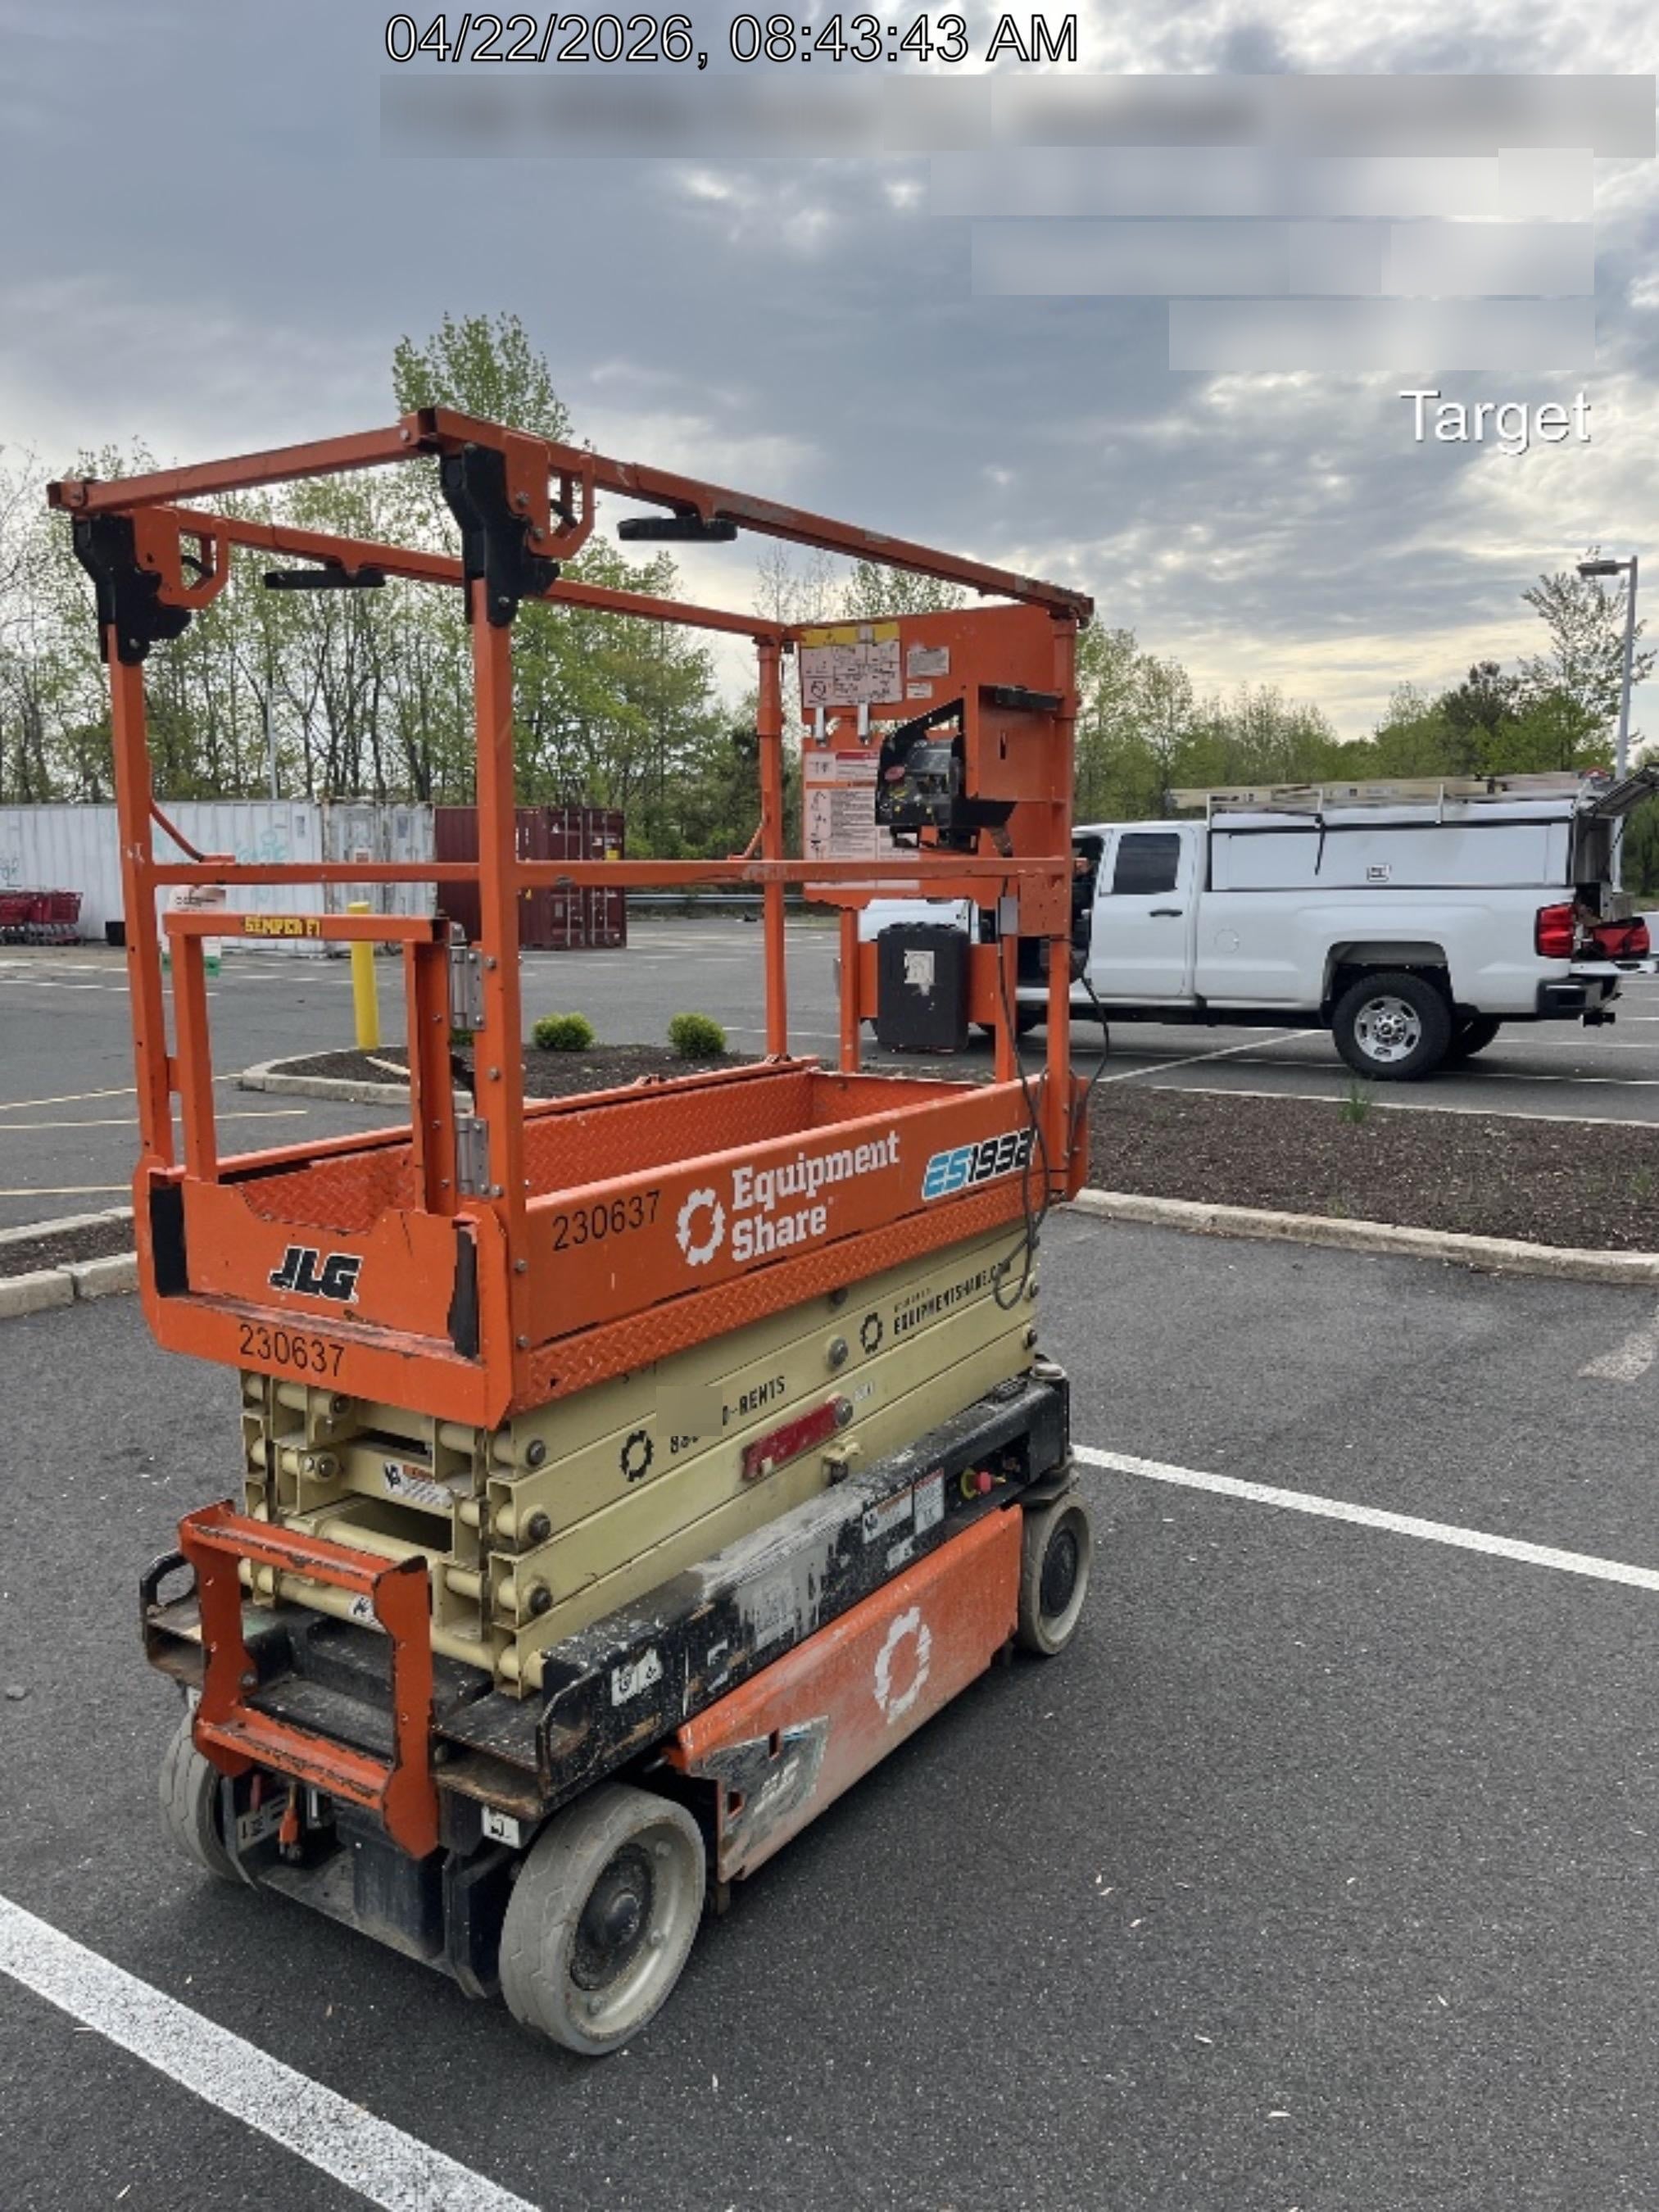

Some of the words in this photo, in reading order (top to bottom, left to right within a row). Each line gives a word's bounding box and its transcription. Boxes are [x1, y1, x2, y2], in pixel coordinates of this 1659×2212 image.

[732, 1130, 900, 1212] Equipment
[552, 1188, 661, 1252] 230637
[732, 1204, 827, 1262] Share
[267, 1244, 364, 1304] JLG
[239, 1323, 345, 1377] 230637
